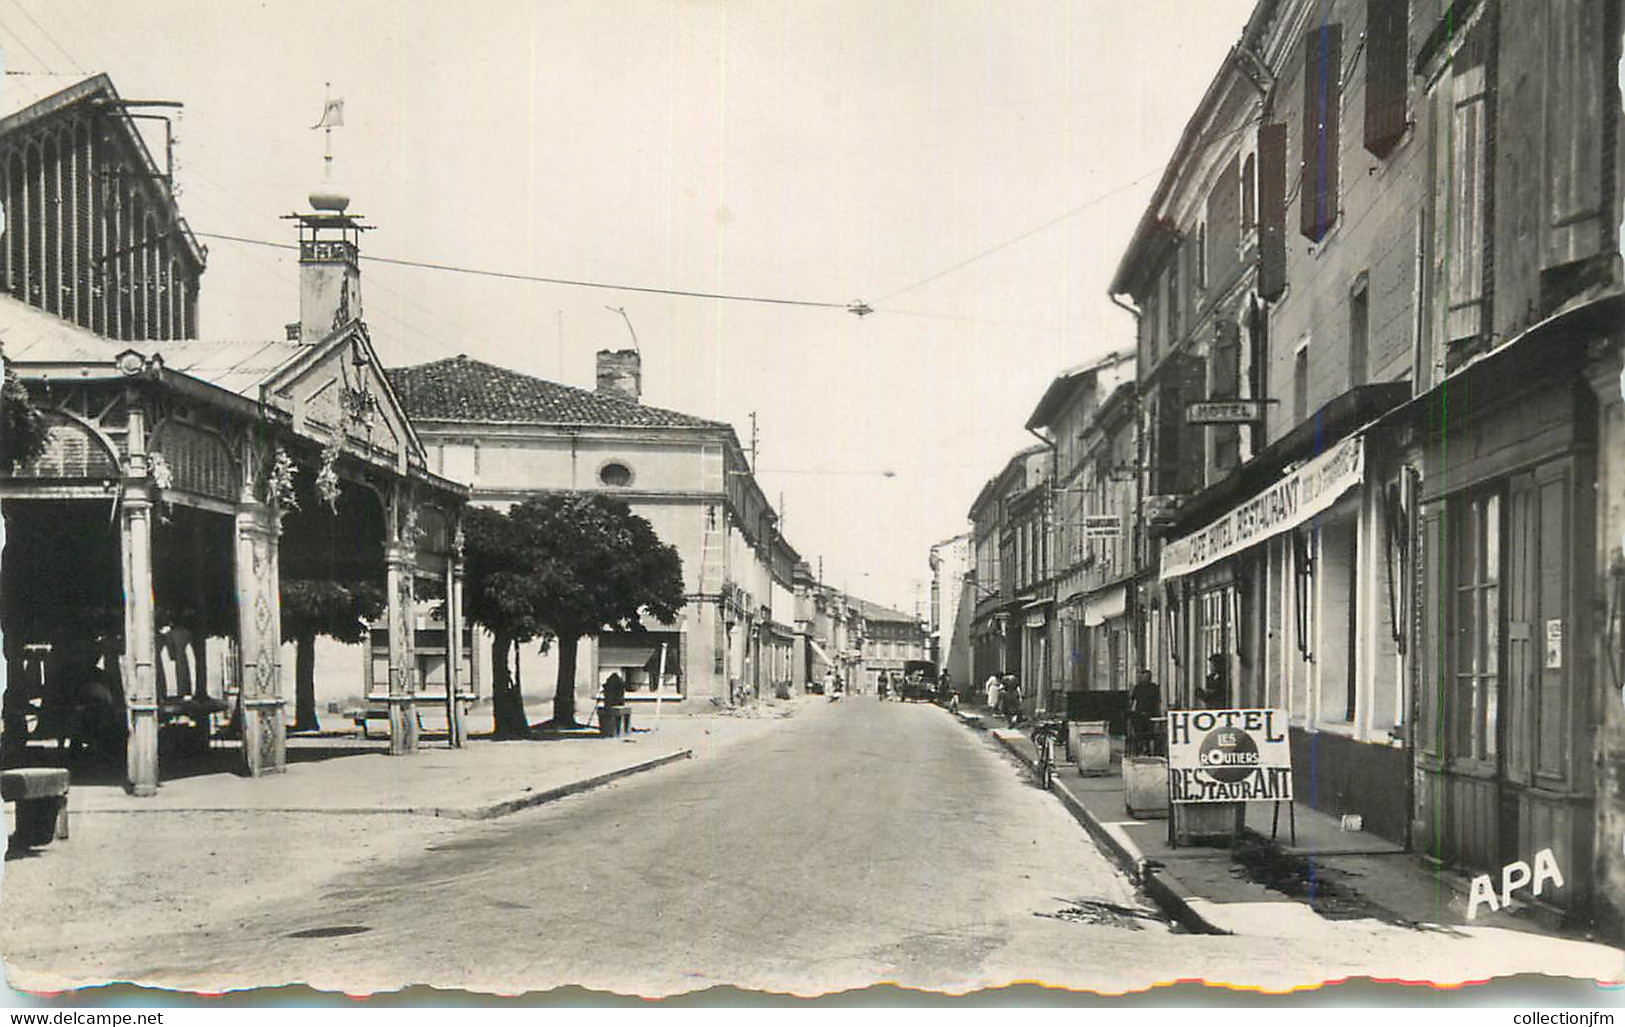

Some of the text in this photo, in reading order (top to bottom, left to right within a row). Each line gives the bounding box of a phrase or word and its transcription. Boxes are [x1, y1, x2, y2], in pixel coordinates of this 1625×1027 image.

[1198, 404, 1251, 419] HOTEL
[1207, 516, 1233, 556] HOTEL
[1236, 475, 1300, 541] RESTAURANT
[1170, 711, 1285, 745] HOTEL
[1218, 732, 1237, 747] LES
[1201, 749, 1259, 766] ROUTIERS
[1171, 767, 1290, 801] RESTAURANT
